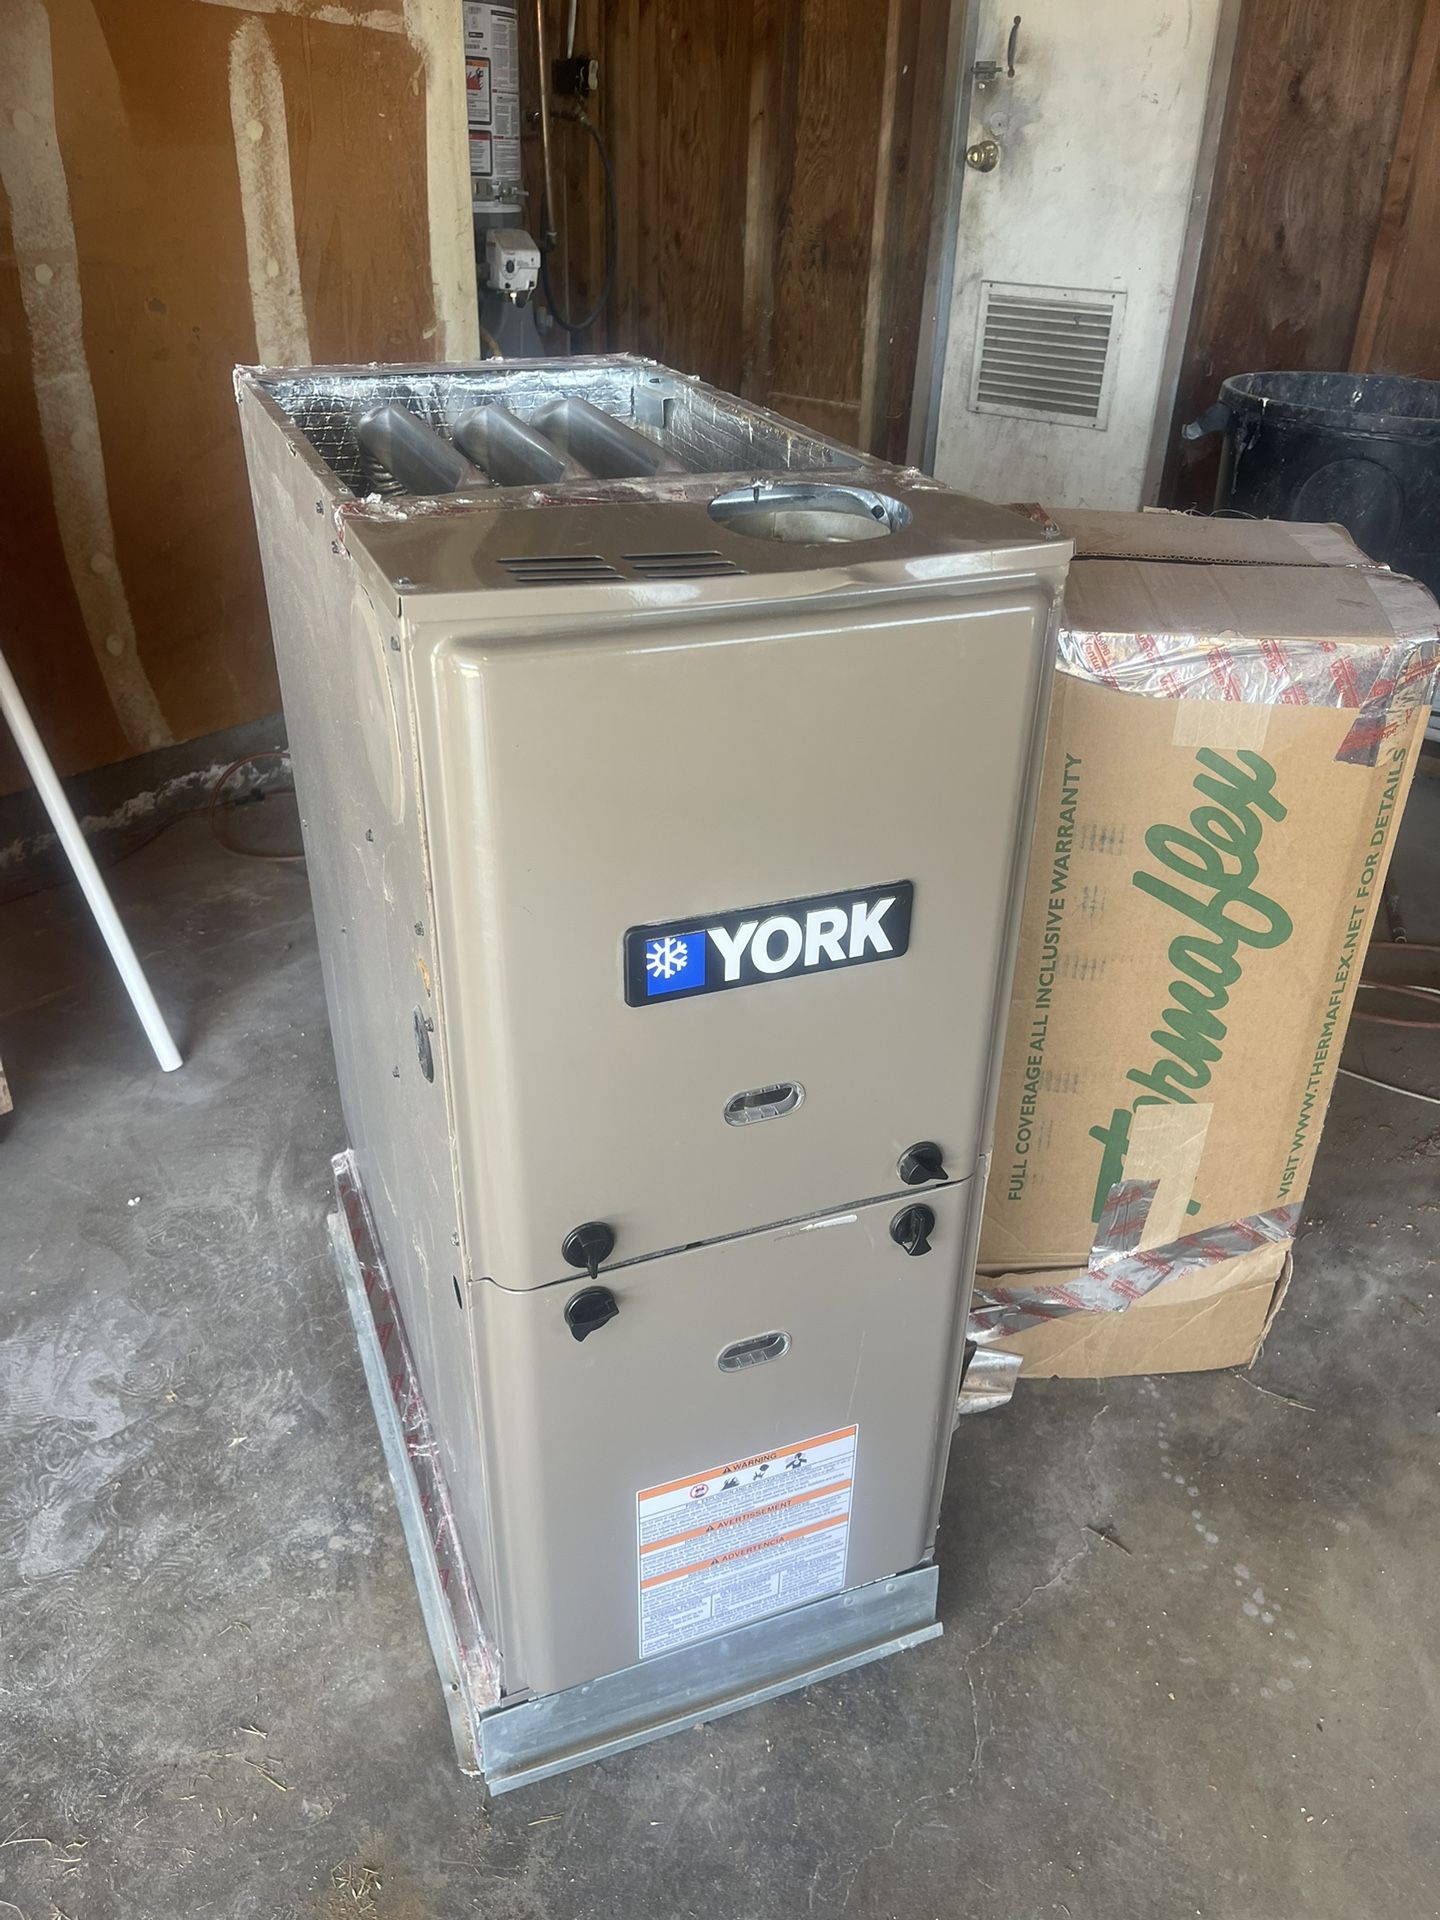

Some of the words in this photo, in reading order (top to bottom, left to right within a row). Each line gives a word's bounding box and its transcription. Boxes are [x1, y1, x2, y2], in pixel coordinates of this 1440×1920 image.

[1050, 753, 1082, 894] WARRANTY
[706, 897, 897, 983] YORK
[1035, 898, 1065, 1008] INCLUSIVE
[1277, 1156, 1300, 1198] VISIT
[1291, 905, 1365, 1153] WWW.THERMAFLEX.NET
[1356, 852, 1380, 898] FOR
[1370, 748, 1407, 847] DETAILS
[1030, 1015, 1049, 1051] ALL
[1015, 1056, 1043, 1154] COVERAGE
[1008, 1159, 1028, 1200] FULL
[733, 1453, 777, 1472] WARNING
[717, 1500, 793, 1529] AVERTISSEMENT
[721, 1536, 785, 1562] ADVERTENCIA
